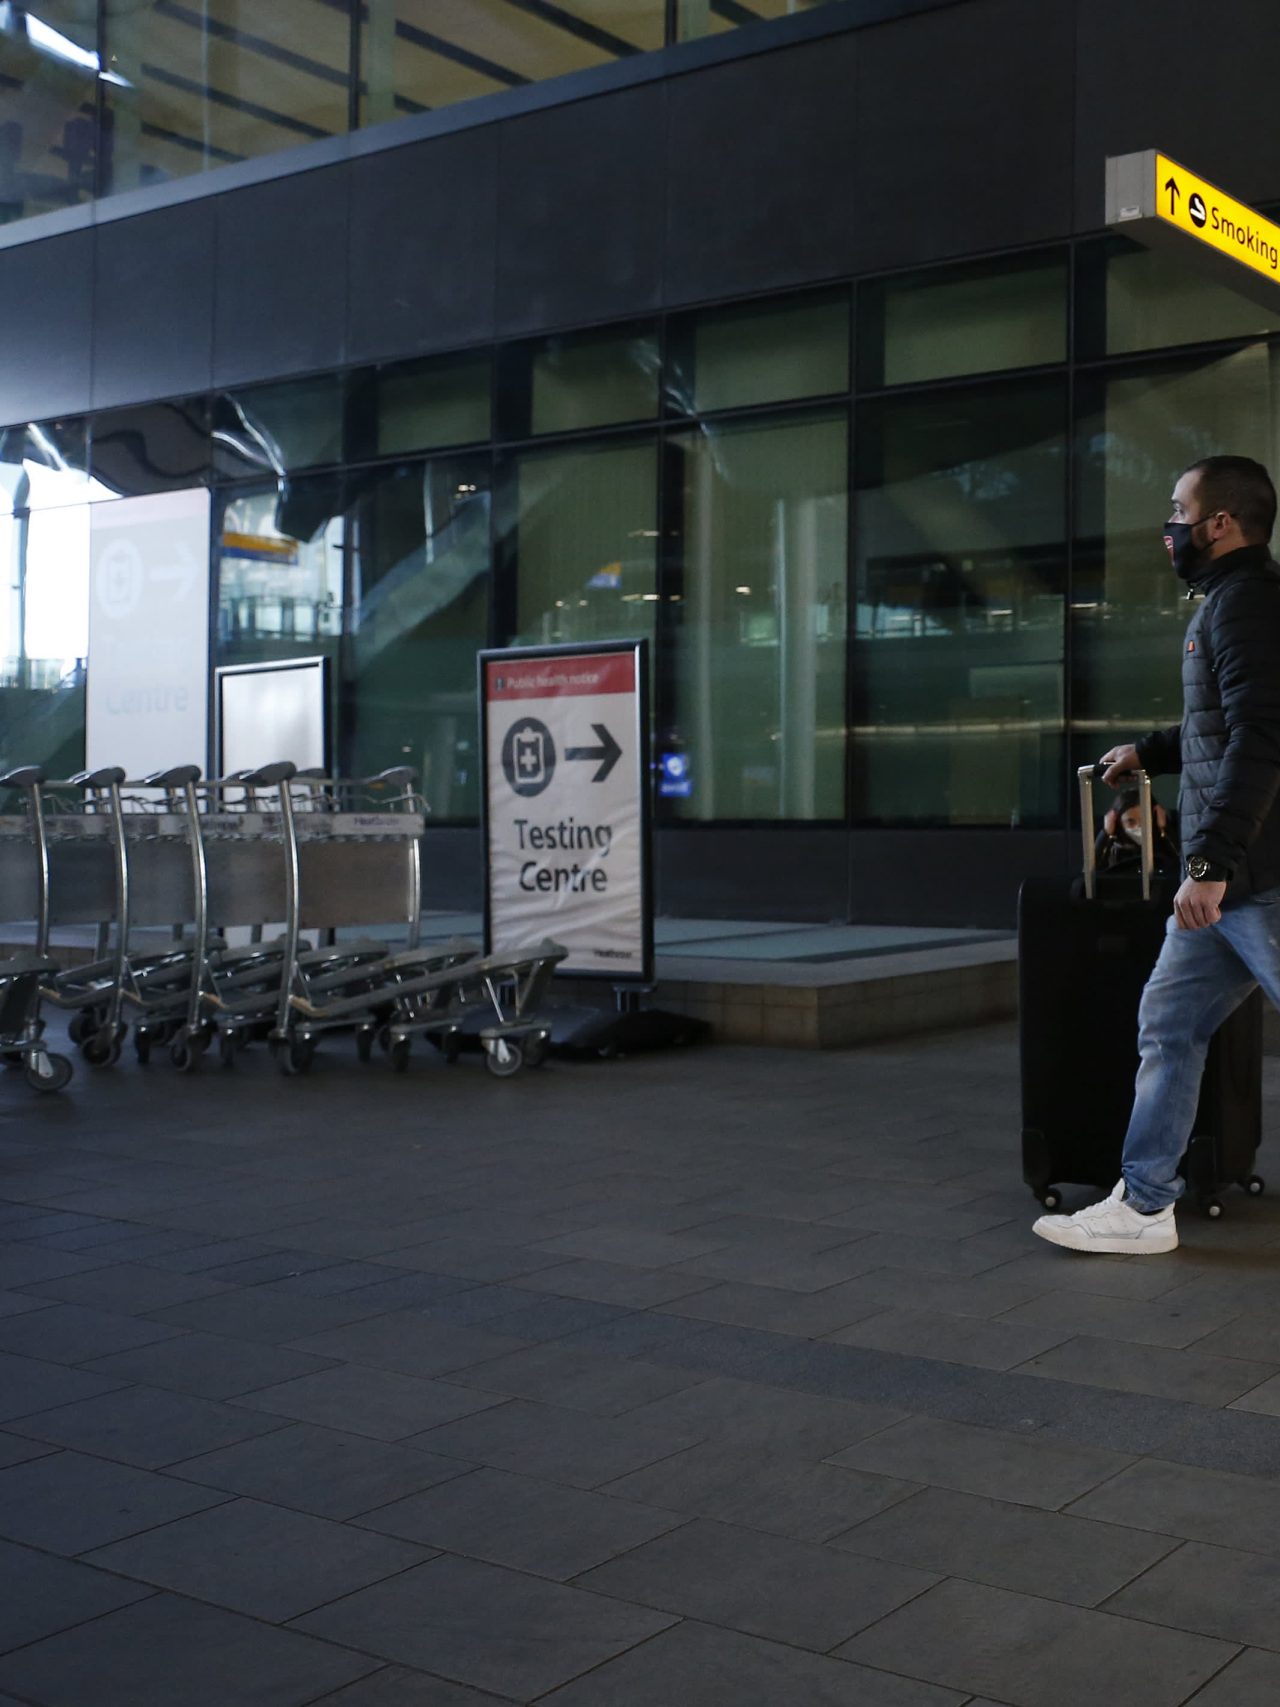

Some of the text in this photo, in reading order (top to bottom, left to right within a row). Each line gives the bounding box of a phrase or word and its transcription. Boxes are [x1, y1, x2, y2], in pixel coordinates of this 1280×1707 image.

[1212, 207, 1277, 269] Smoking
[514, 817, 613, 857] Testing
[519, 861, 608, 893] Centre
